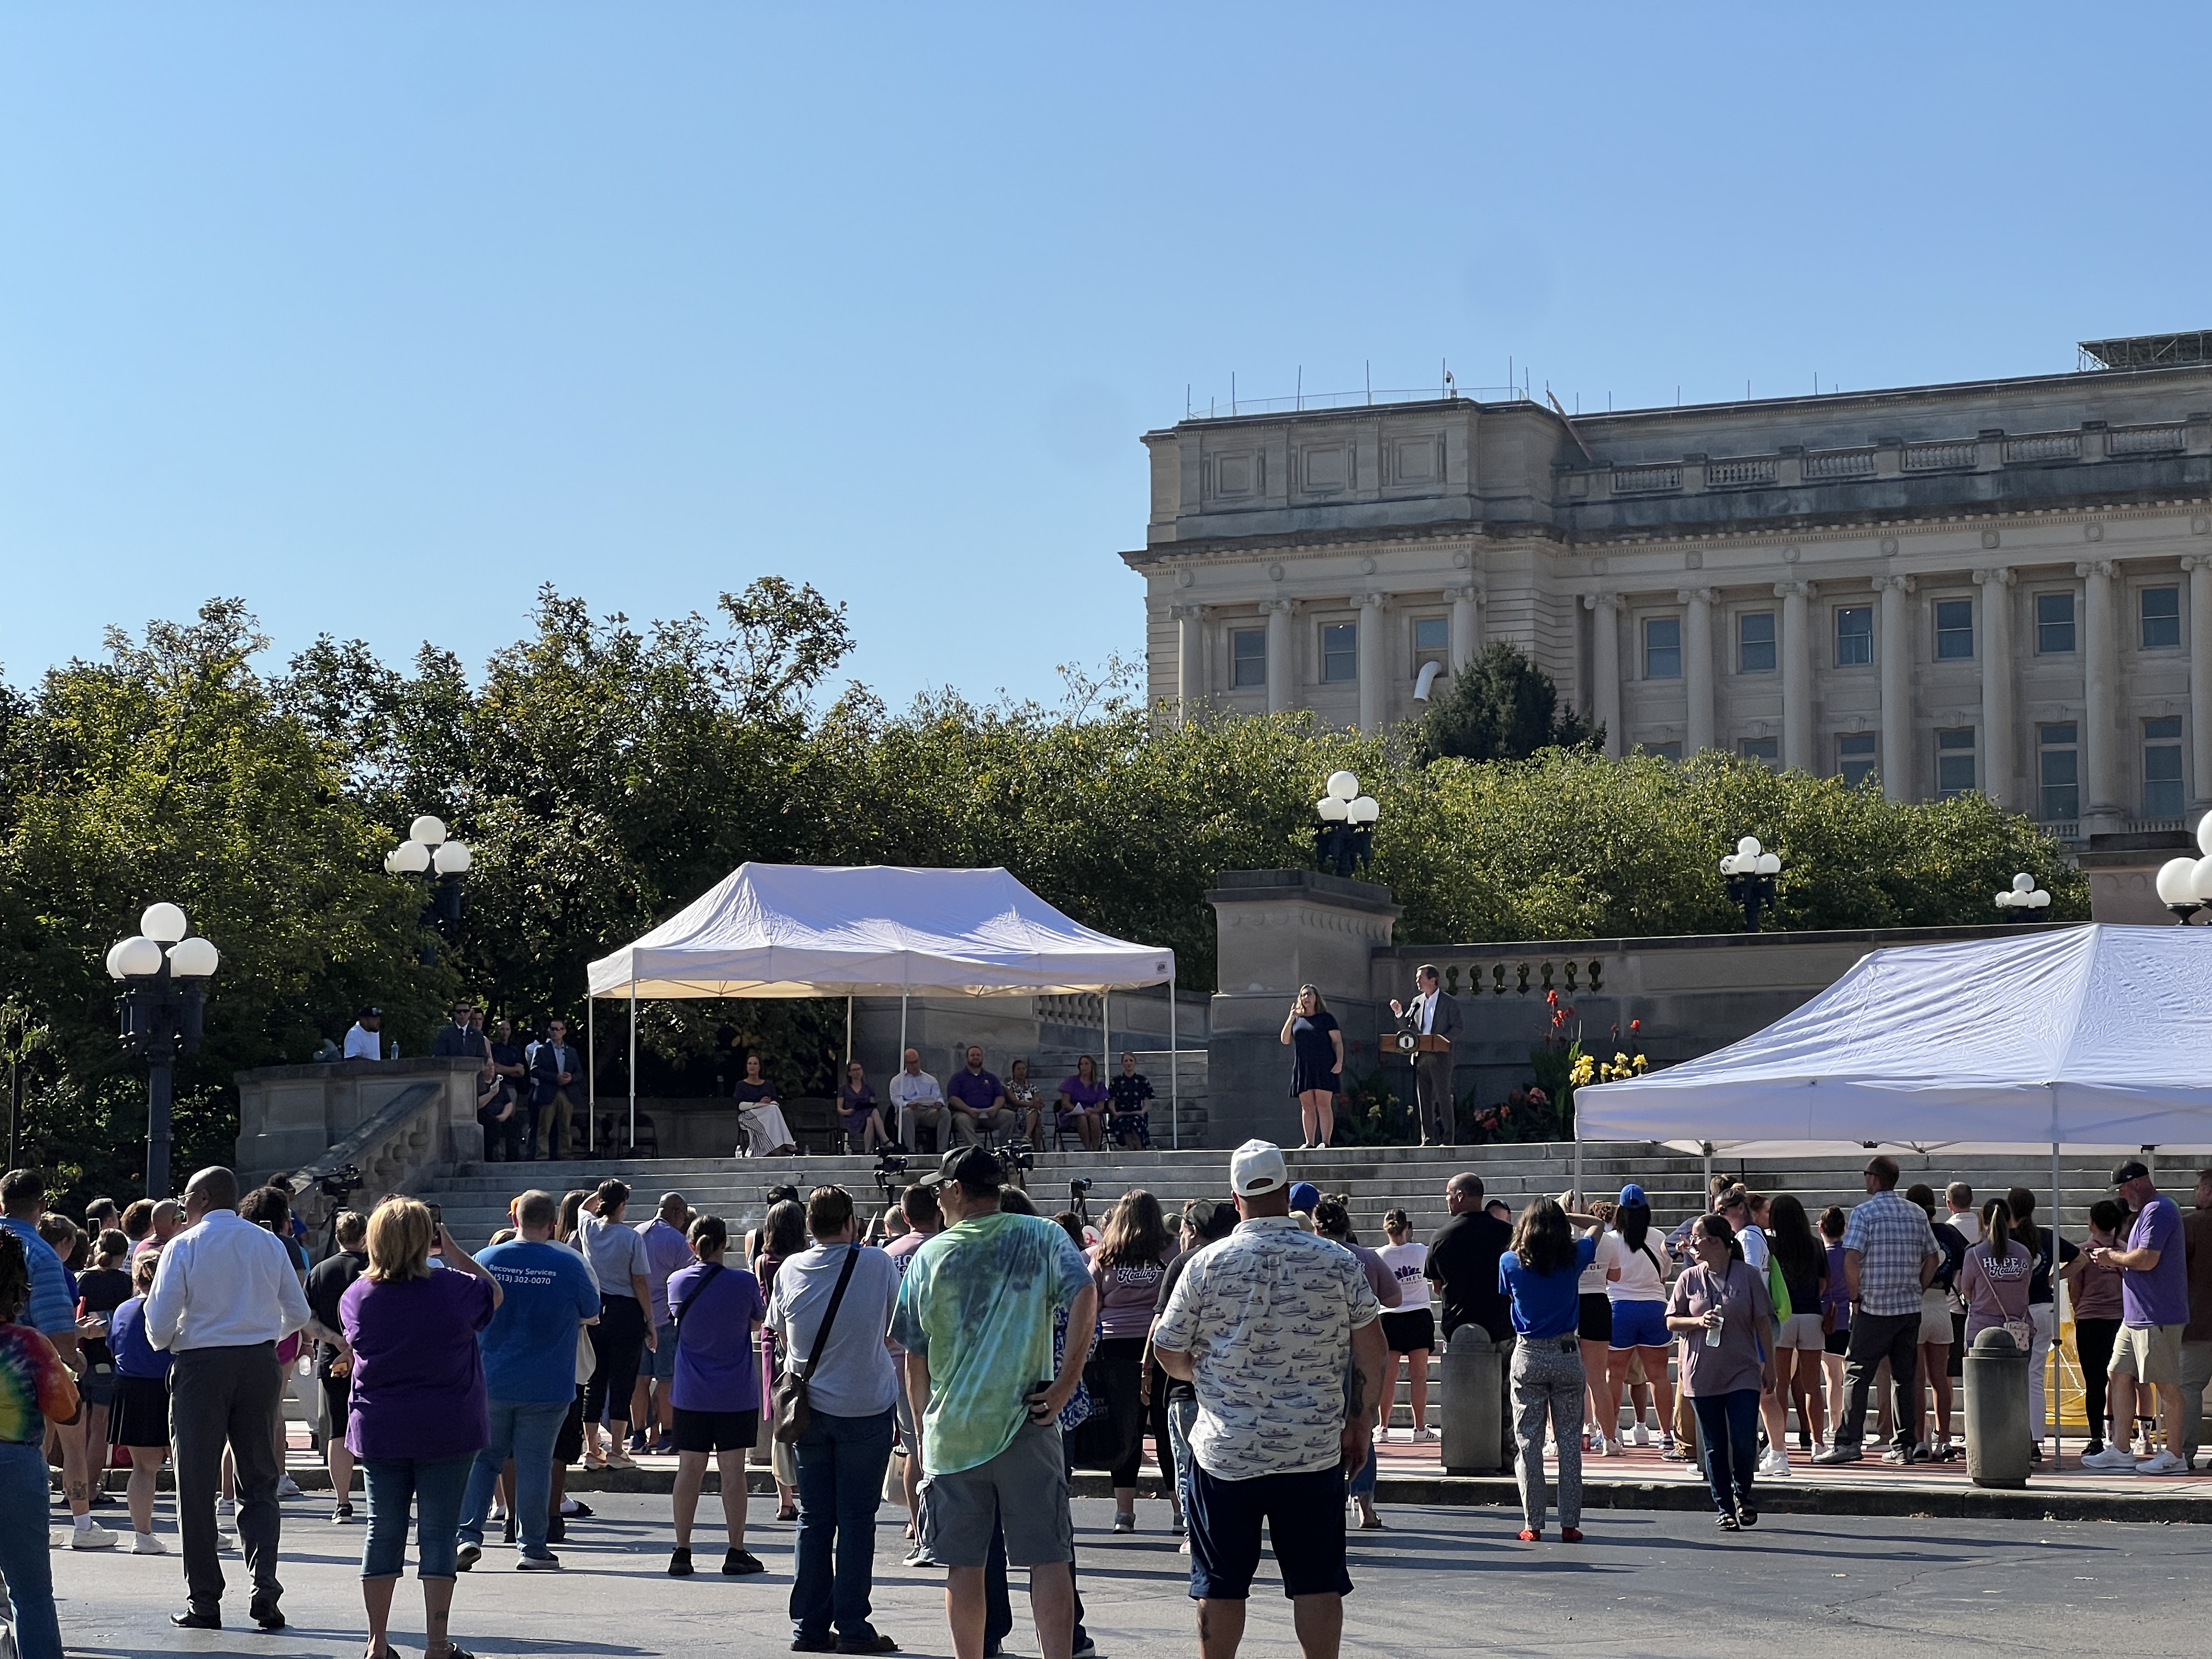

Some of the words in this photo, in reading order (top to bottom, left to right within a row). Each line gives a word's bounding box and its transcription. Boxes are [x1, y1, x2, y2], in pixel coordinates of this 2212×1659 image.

[489, 1264, 524, 1275] Recovery
[525, 1268, 557, 1277] Services
[1116, 1266, 1158, 1284] Healing
[1989, 1265, 2025, 1278] Healing
[494, 1273, 512, 1283] (513)
[514, 1276, 551, 1285] 302-0070
